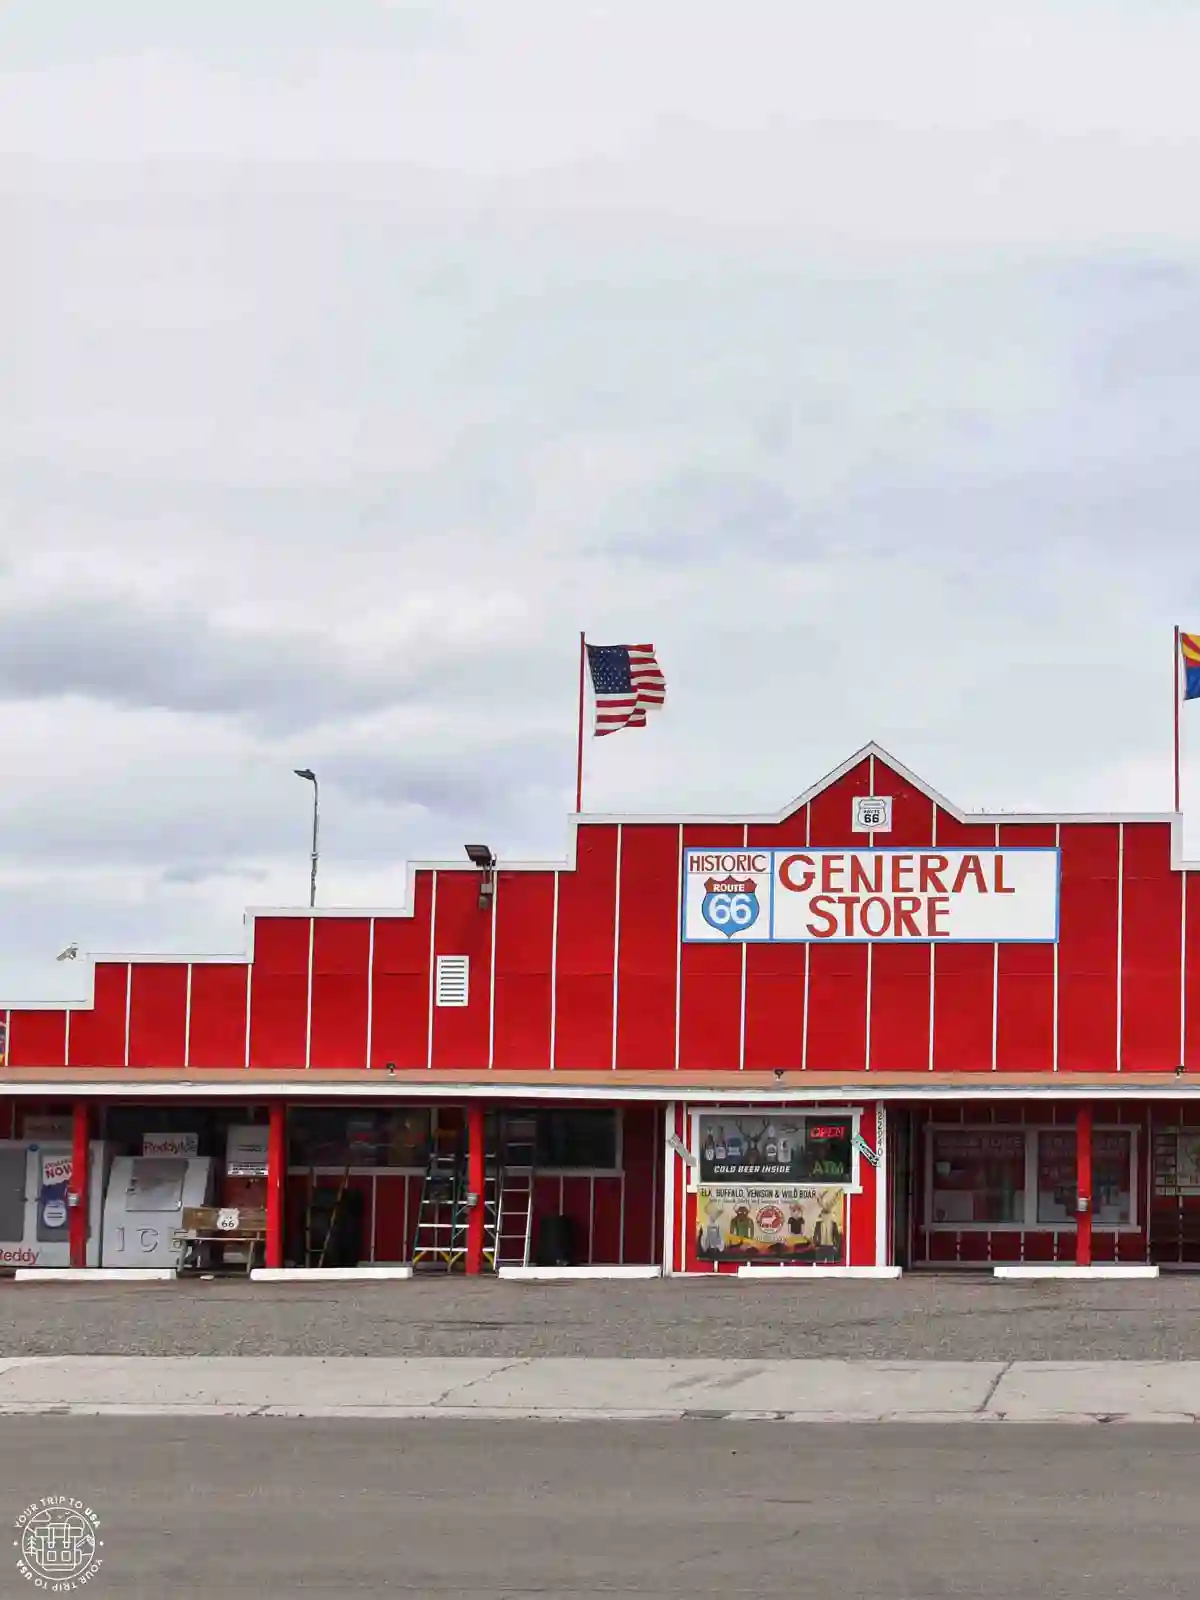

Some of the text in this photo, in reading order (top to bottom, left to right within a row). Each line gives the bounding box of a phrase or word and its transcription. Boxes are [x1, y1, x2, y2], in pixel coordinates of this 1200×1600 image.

[864, 814, 880, 823] 66
[689, 854, 767, 873] HISTORIC
[778, 853, 1016, 894] GENERAL
[713, 883, 745, 893] ROUTE
[708, 893, 753, 925] 66
[806, 895, 951, 938] STORE
[810, 1126, 845, 1140] OPEN
[714, 1165, 790, 1174] COLD BEER INSIDE
[747, 1188, 773, 1198] VENISON
[774, 1188, 780, 1198] &
[782, 1188, 799, 1198] WILD
[799, 1189, 817, 1199] BOAR
[221, 1219, 235, 1228] 66
